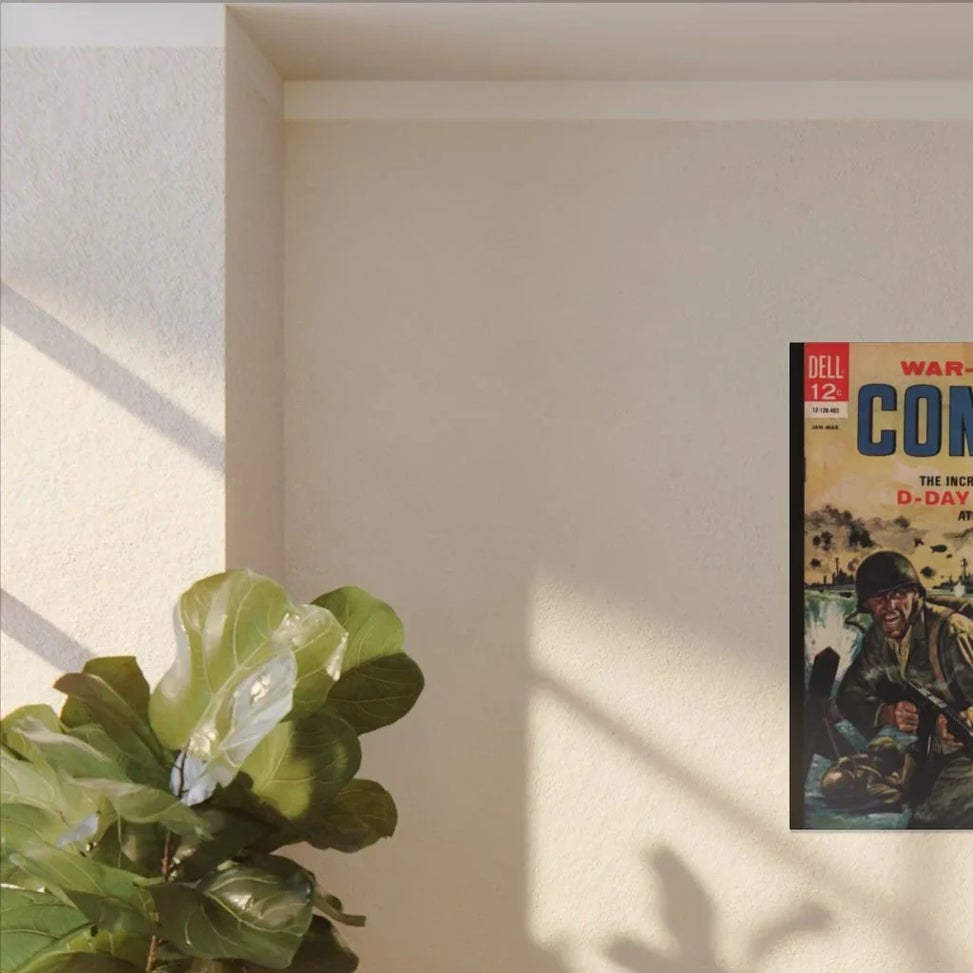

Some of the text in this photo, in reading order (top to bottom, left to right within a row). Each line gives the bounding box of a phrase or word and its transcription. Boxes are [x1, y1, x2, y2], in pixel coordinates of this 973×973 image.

[808, 355, 844, 379] DELL
[920, 476, 941, 487] THE
[897, 491, 970, 506] D-DAY
[958, 511, 973, 522] AT
